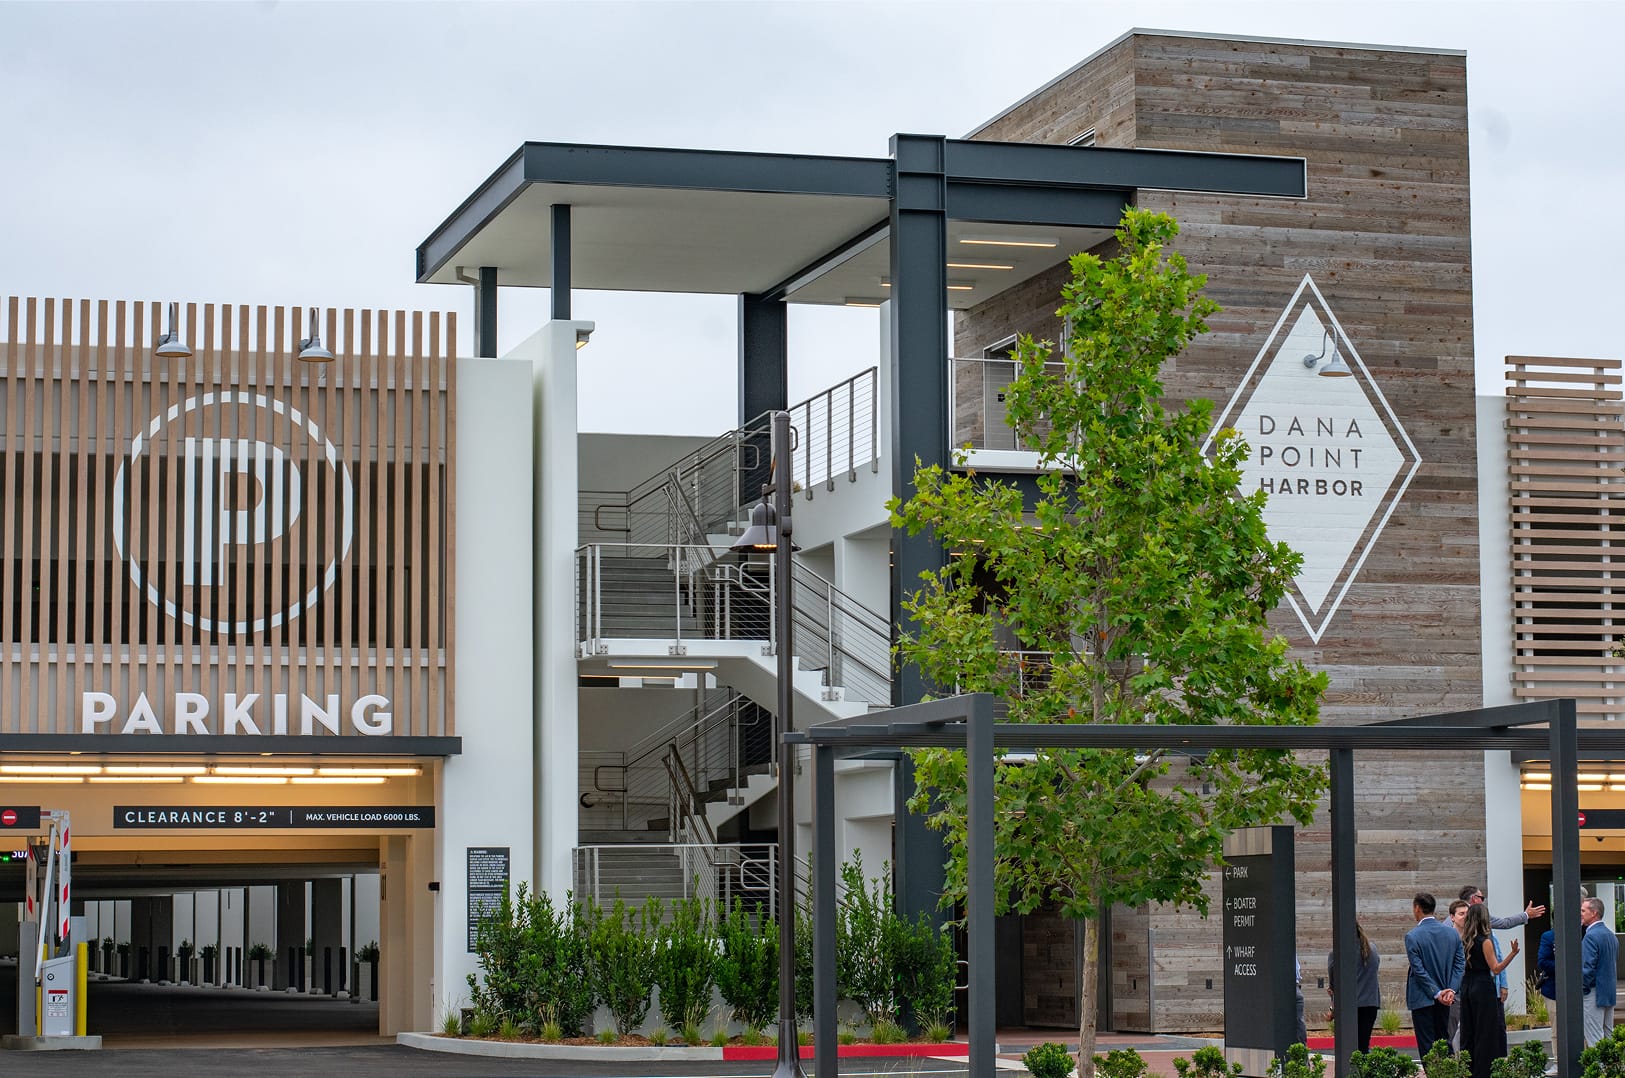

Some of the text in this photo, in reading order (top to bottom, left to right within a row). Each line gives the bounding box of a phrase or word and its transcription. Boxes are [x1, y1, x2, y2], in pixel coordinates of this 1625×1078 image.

[1260, 415, 1363, 438] DANA
[1260, 446, 1362, 468] POINT
[1260, 477, 1363, 497] HARBOR
[183, 436, 301, 586] P
[82, 692, 392, 736] PARKING
[125, 811, 276, 823] CLEARANCE 8'-2"
[305, 813, 420, 821] MAX. VEHICLE LOAD 6000 LBS.
[1233, 866, 1249, 879] PARK
[1233, 897, 1257, 909] BOATER
[1233, 915, 1255, 927] PERMIT
[1234, 946, 1255, 958] WHARF
[1234, 964, 1257, 976] ACCESS
